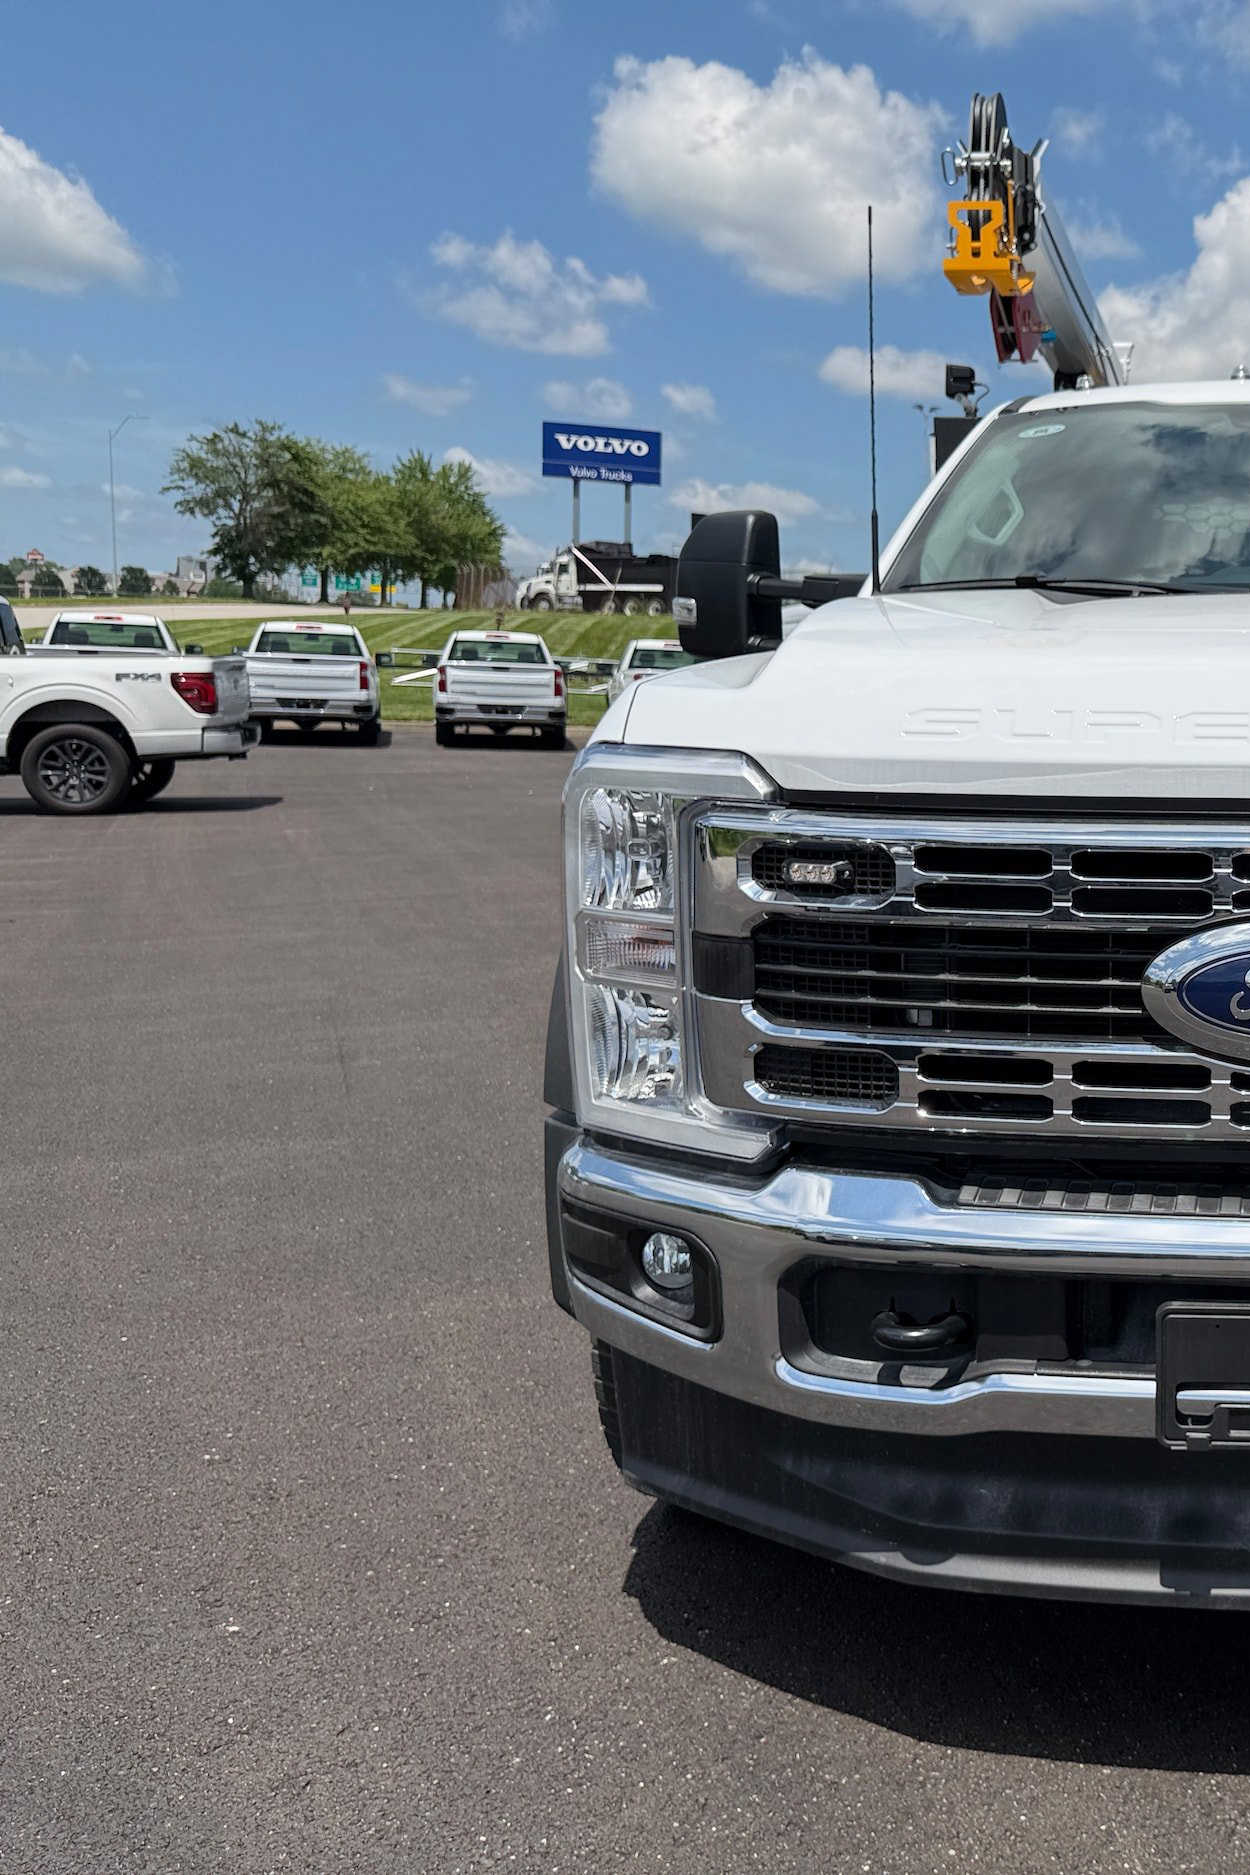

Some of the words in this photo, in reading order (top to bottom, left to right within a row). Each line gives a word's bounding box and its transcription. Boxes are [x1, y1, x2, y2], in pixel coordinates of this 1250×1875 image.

[554, 432, 649, 457] VOLVO
[569, 465, 597, 479] Volvo
[600, 467, 632, 482] Trucks
[115, 672, 161, 682] FX4
